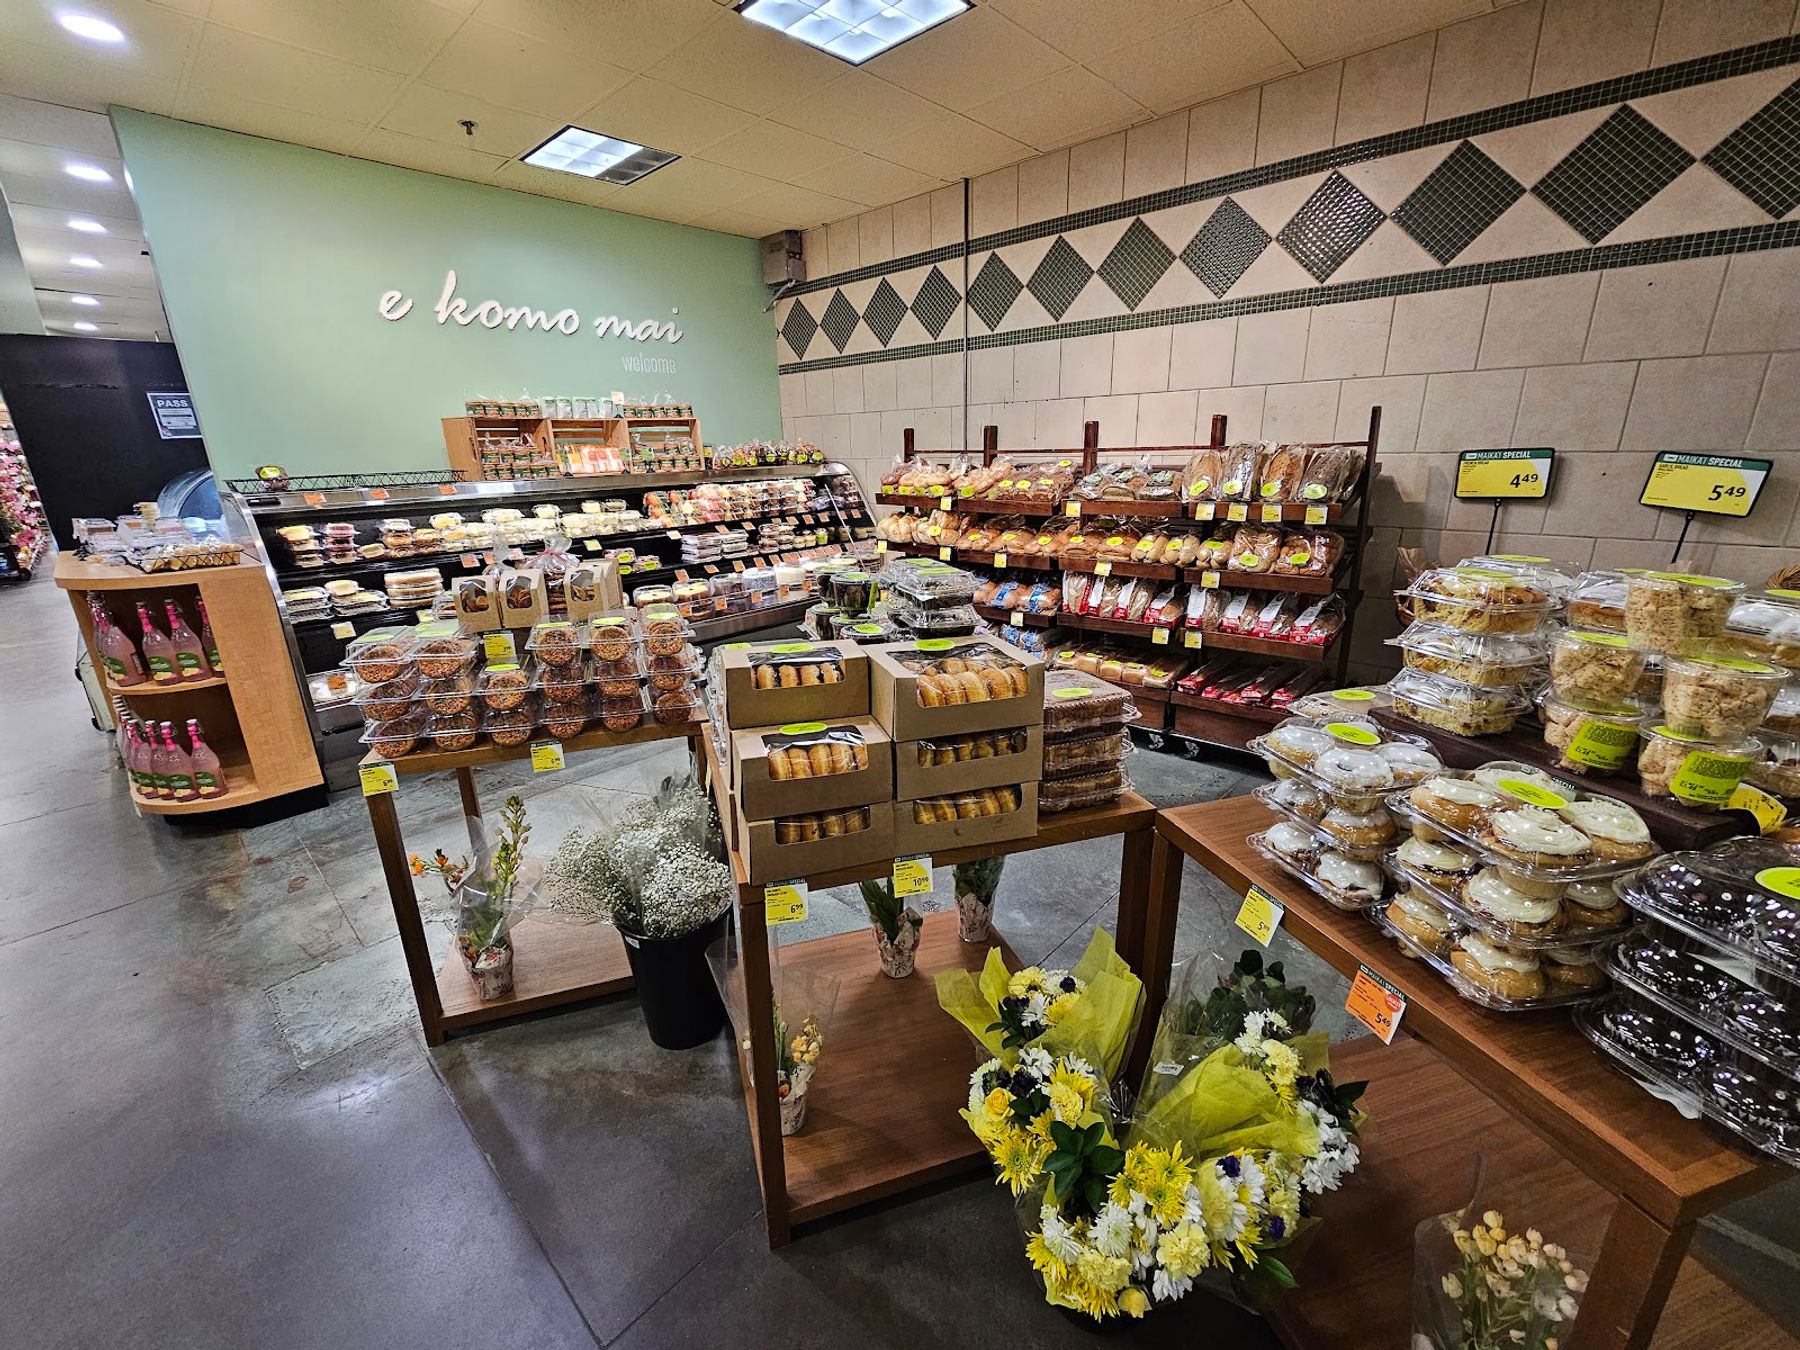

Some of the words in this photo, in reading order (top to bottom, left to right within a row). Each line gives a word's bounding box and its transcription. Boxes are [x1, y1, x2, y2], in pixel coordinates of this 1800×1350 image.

[379, 290, 413, 321] e
[434, 269, 581, 335] komo
[594, 307, 683, 344] mai
[622, 353, 676, 373] welcome
[1502, 451, 1531, 459] SPECIAL
[1708, 457, 1743, 468] SPECIAL
[1384, 982, 1405, 1001] SPECIAL
